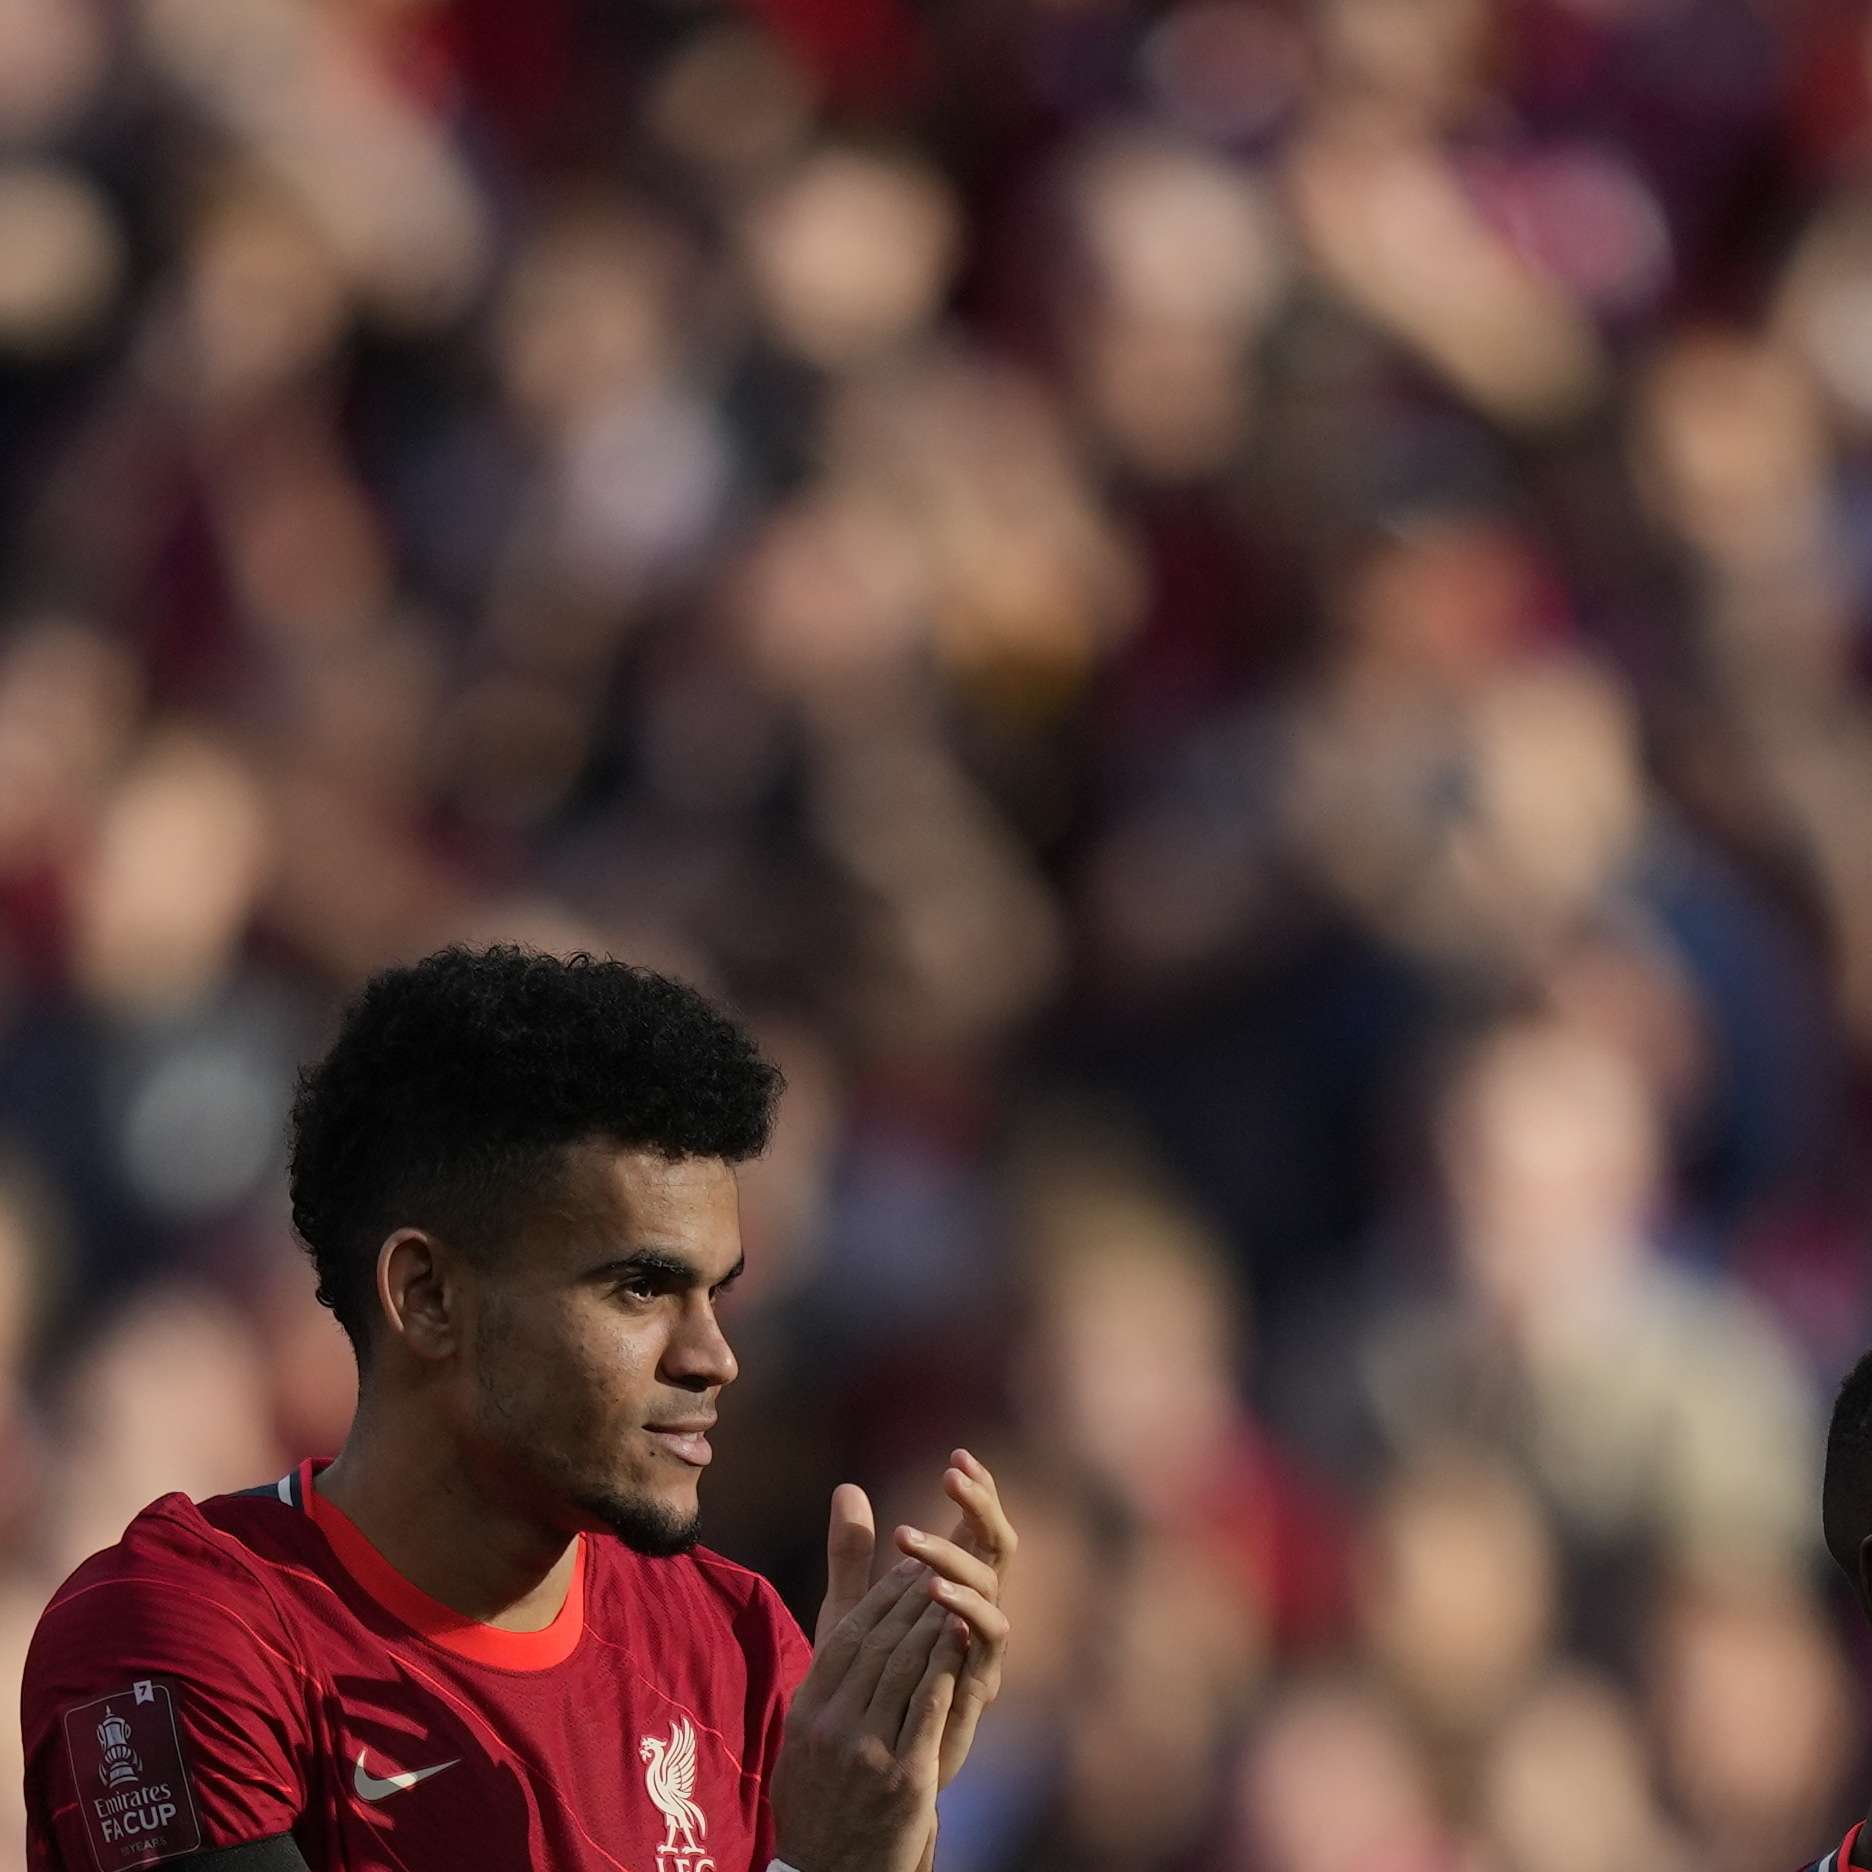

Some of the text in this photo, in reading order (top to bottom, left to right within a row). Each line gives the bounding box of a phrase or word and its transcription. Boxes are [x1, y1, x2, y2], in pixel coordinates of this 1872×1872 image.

[94, 1784, 172, 1819] Emirates
[101, 1803, 176, 1843] FA CUP
